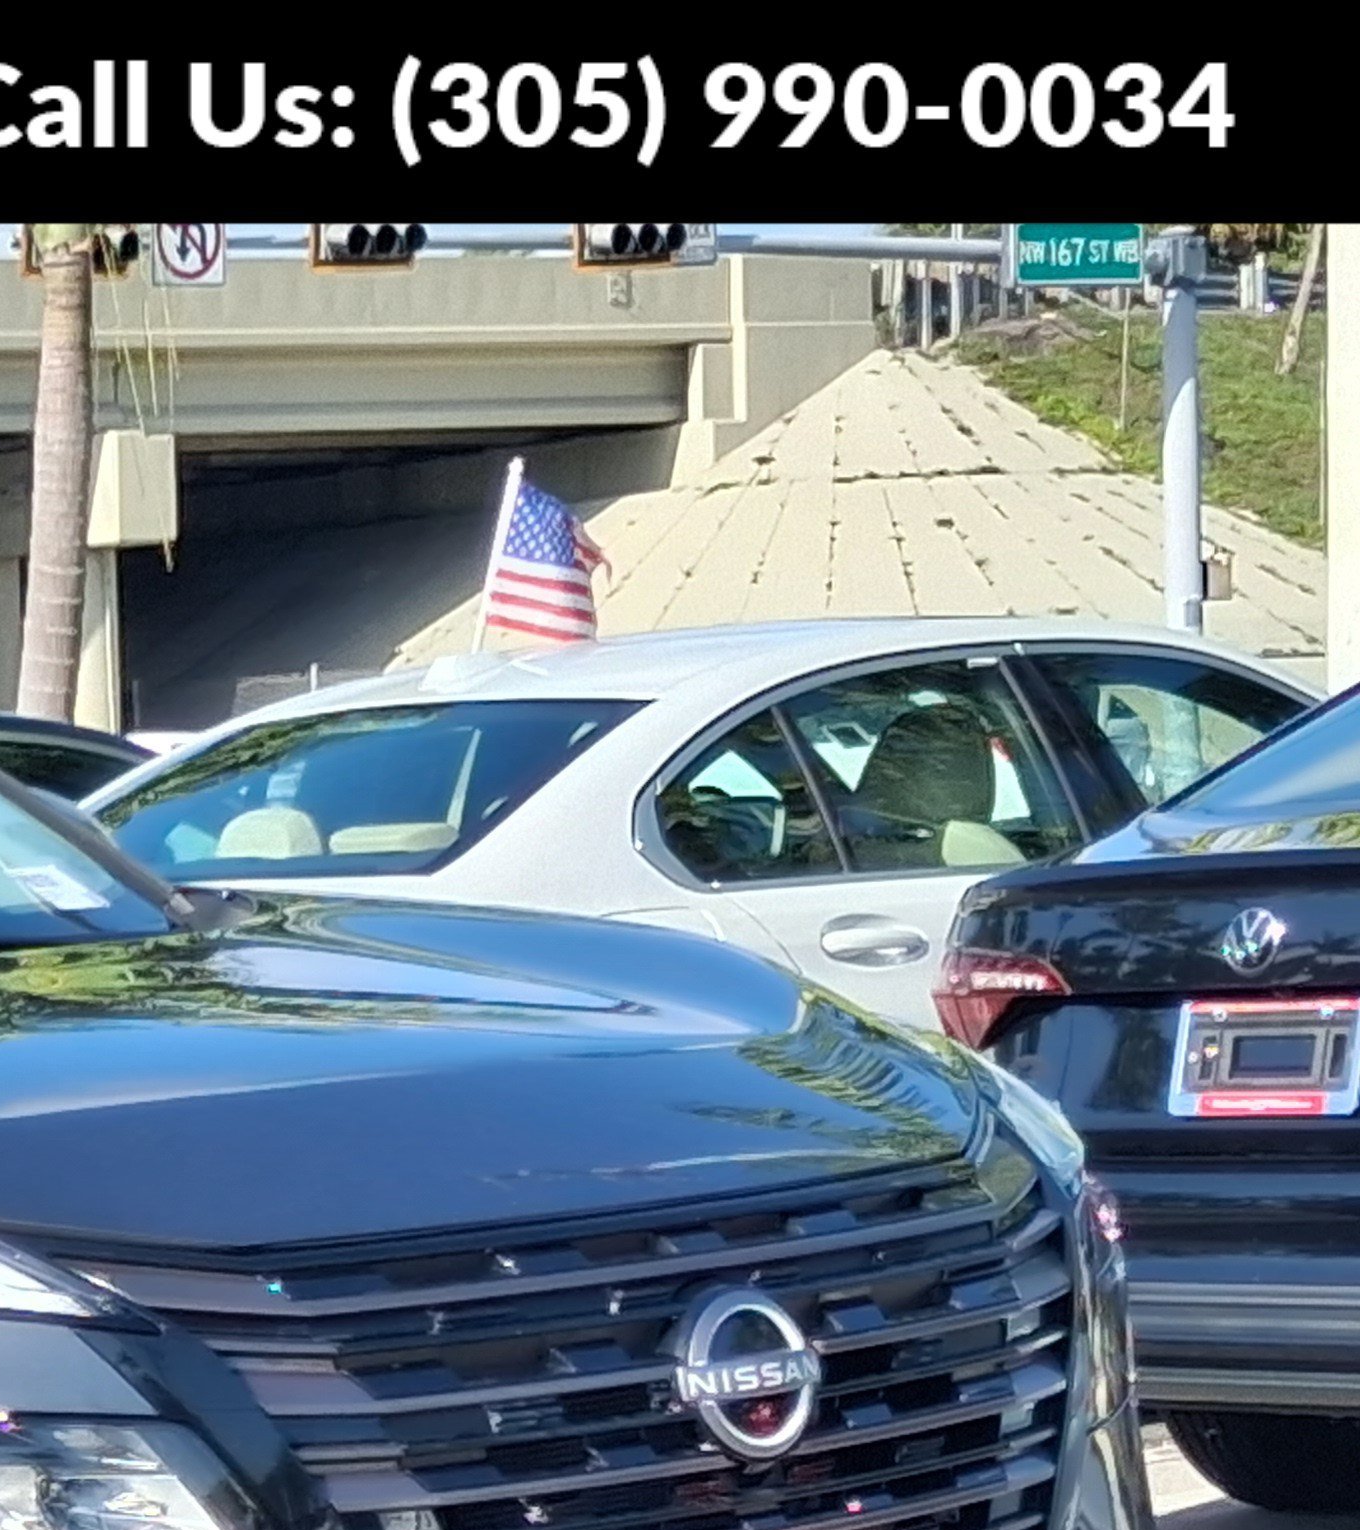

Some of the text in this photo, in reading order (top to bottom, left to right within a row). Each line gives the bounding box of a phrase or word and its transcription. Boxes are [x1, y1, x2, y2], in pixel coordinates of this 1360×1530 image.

[1020, 240, 1046, 264] NW
[1048, 237, 1086, 266] 167
[1088, 239, 1110, 264] ST
[686, 1354, 821, 1399] NISSAN
